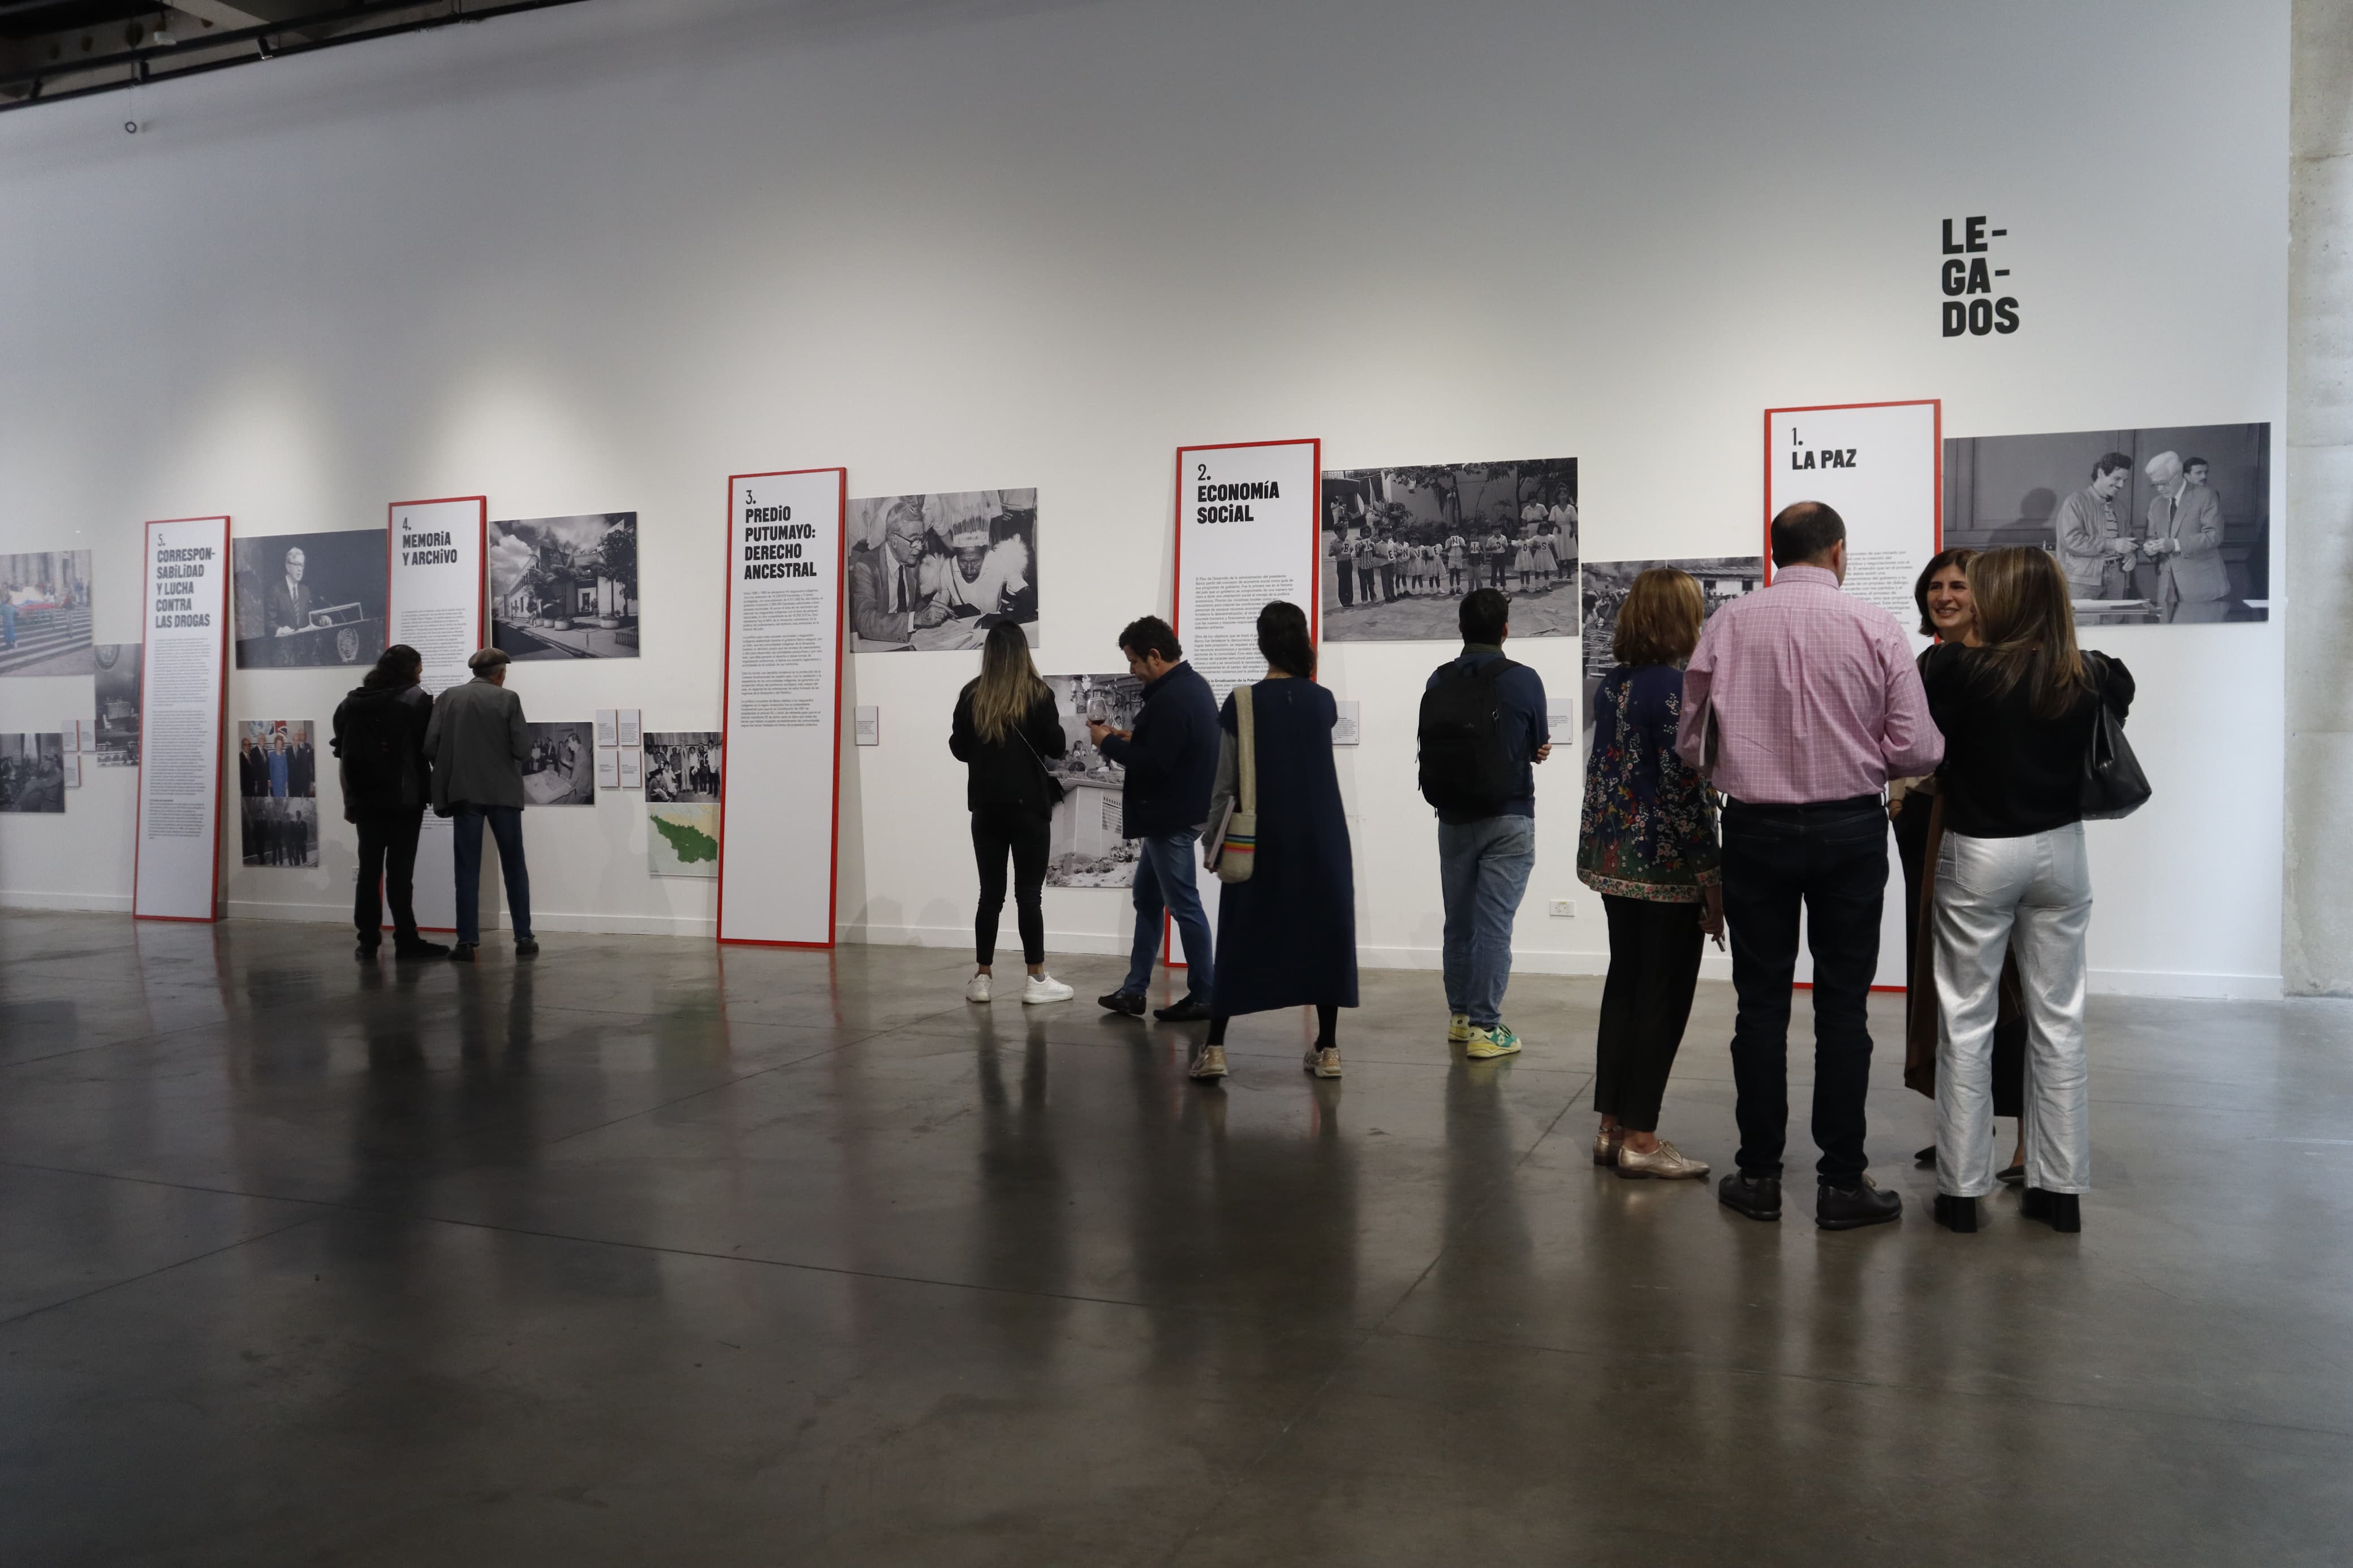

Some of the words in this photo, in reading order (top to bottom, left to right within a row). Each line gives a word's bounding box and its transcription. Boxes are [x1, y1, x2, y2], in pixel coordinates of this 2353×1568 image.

[1942, 215, 2007, 254] LE-
[1942, 257, 2010, 296] GA-
[1943, 296, 2019, 337] DOS
[1792, 427, 1803, 446] 1.
[1792, 451, 1816, 470] LA
[1821, 449, 1856, 469] PAZ
[1198, 464, 1211, 481] 2.
[746, 490, 756, 504] 3.
[403, 517, 411, 530] 4.
[158, 534, 165, 547] 5.
[745, 525, 815, 541] PUTUMAYO:
[157, 547, 215, 561] CORRESPON-
[745, 545, 801, 561] DERECHO
[744, 563, 817, 580] ANCESTRAL
[157, 583, 162, 595] Y
[165, 581, 193, 595] LUCHA
[156, 598, 192, 612] CONTRA
[156, 615, 172, 628] LAS
[174, 614, 210, 628] DROGAS
